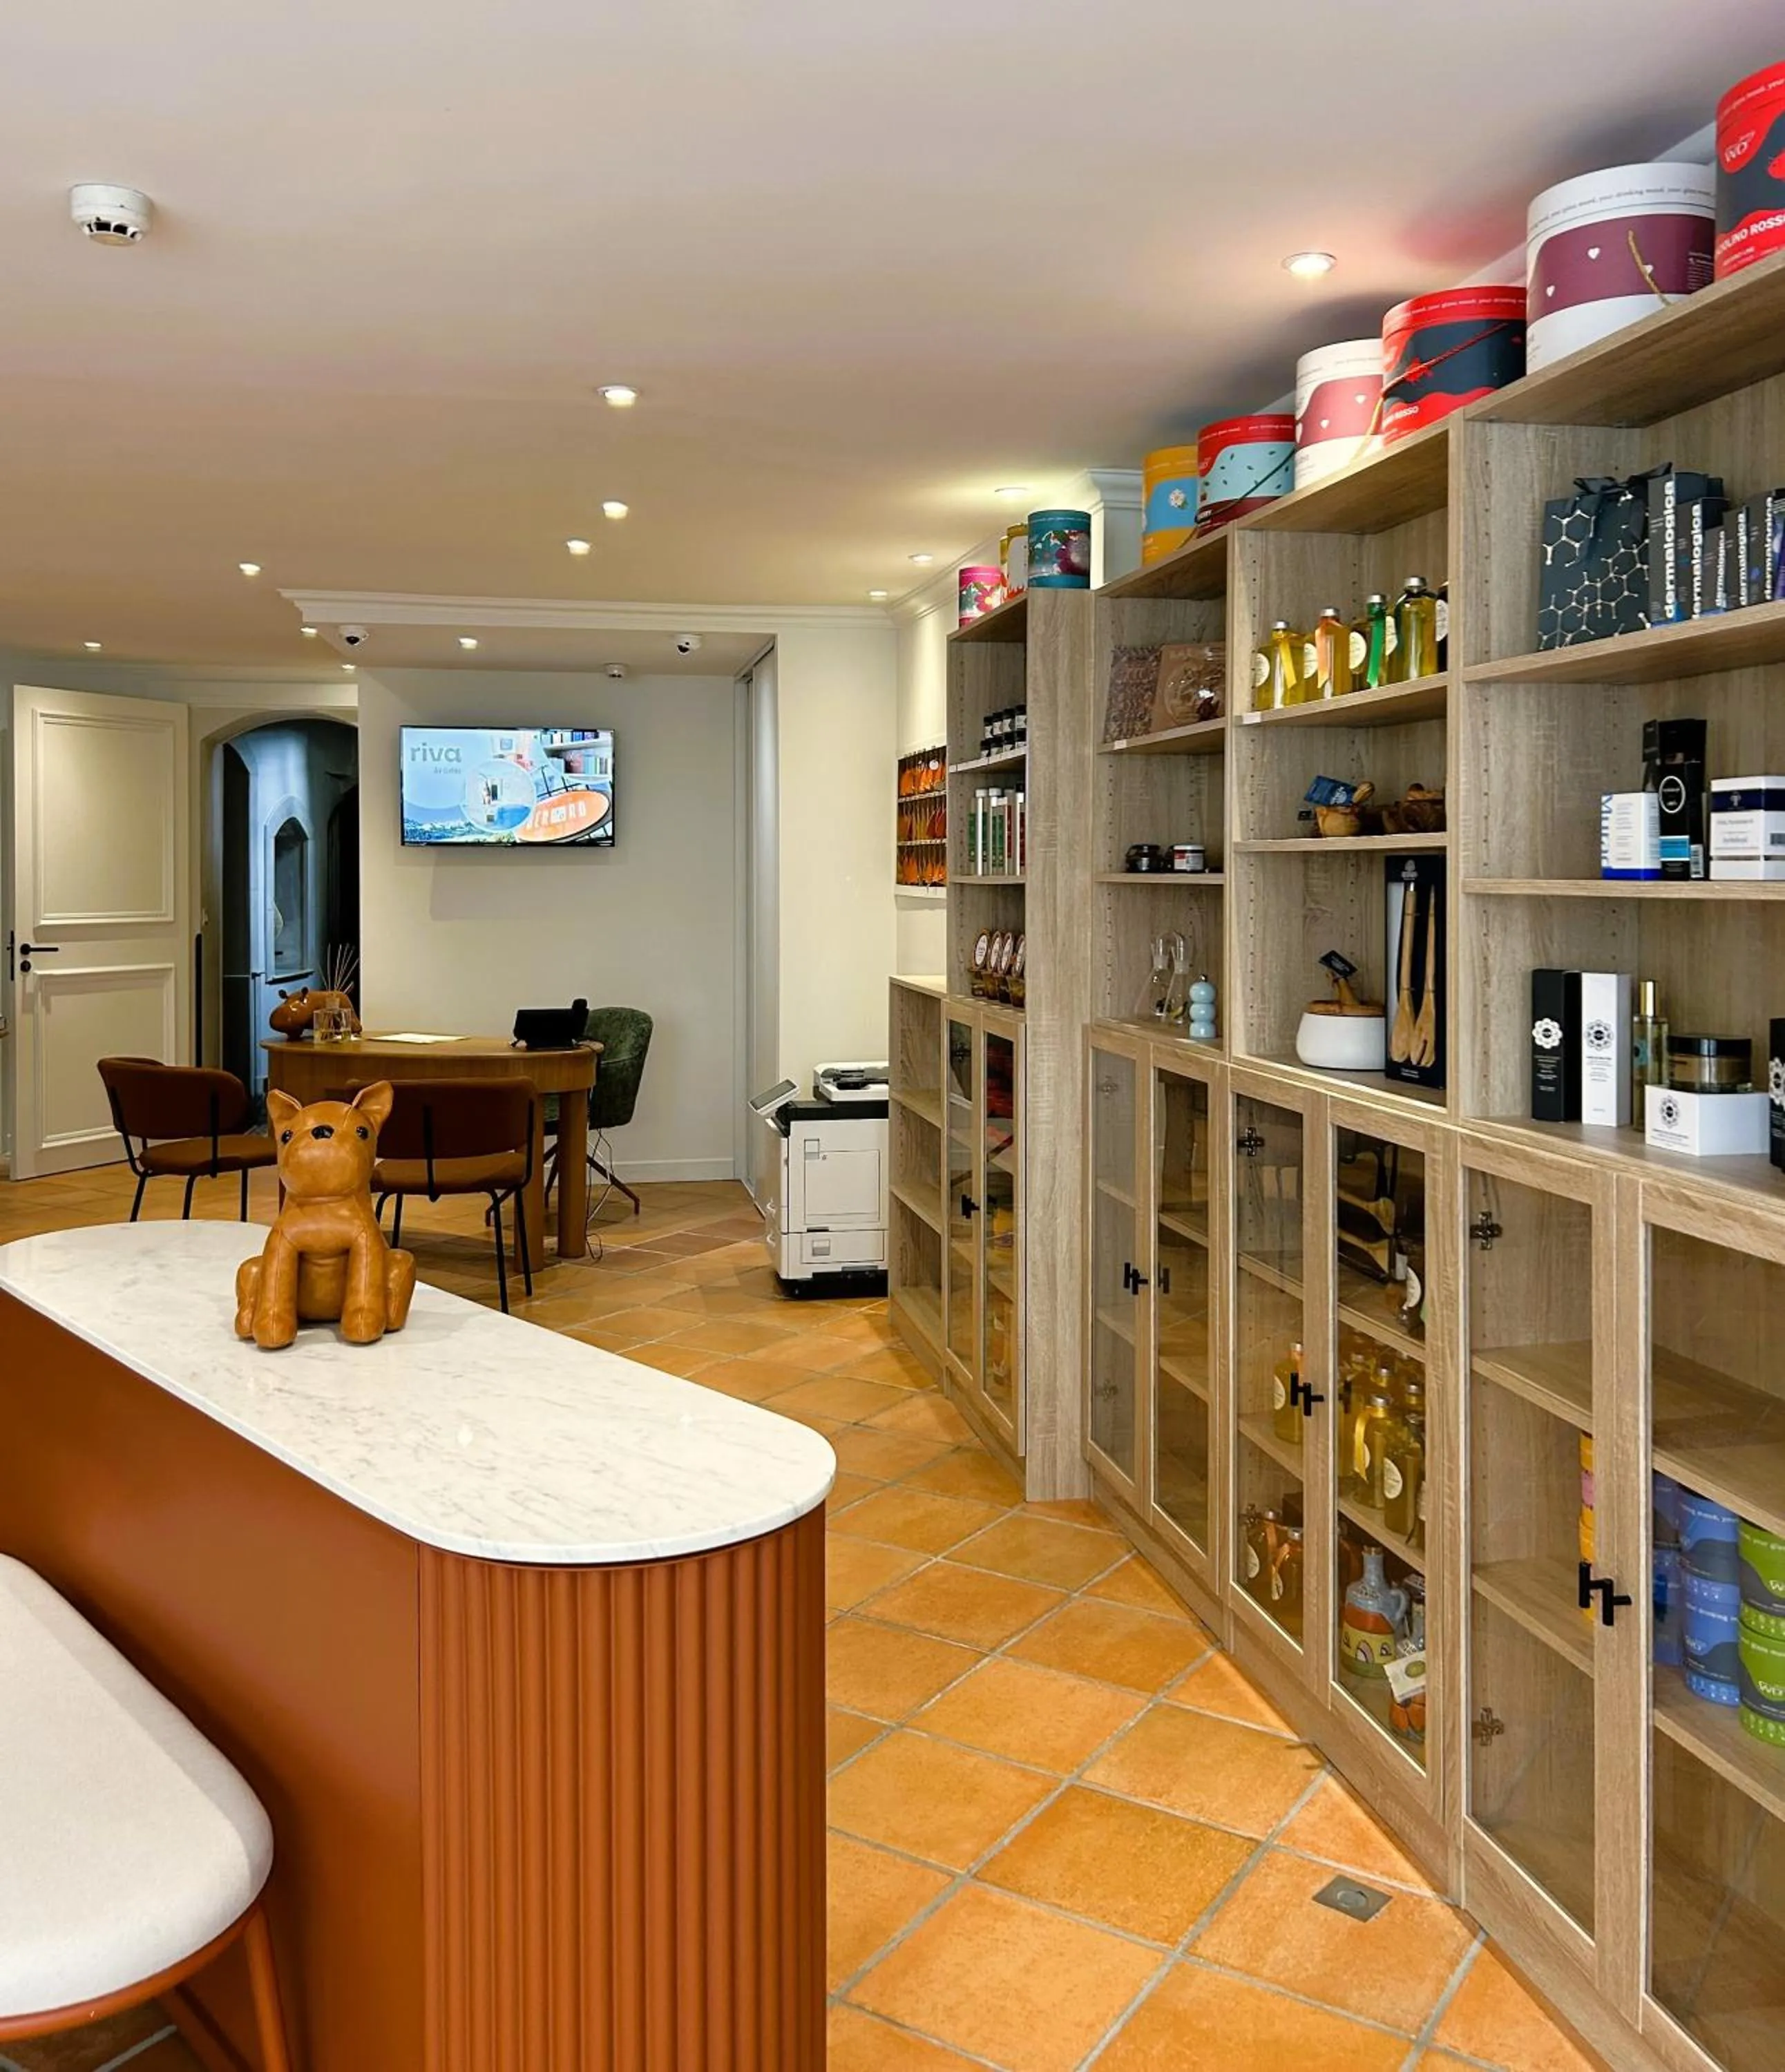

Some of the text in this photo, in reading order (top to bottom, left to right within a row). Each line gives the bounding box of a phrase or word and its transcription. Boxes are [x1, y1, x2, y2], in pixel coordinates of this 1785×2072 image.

[1750, 215, 1785, 236] ROSS
[1663, 481, 1675, 619] dermalogica
[410, 742, 462, 763] riva
